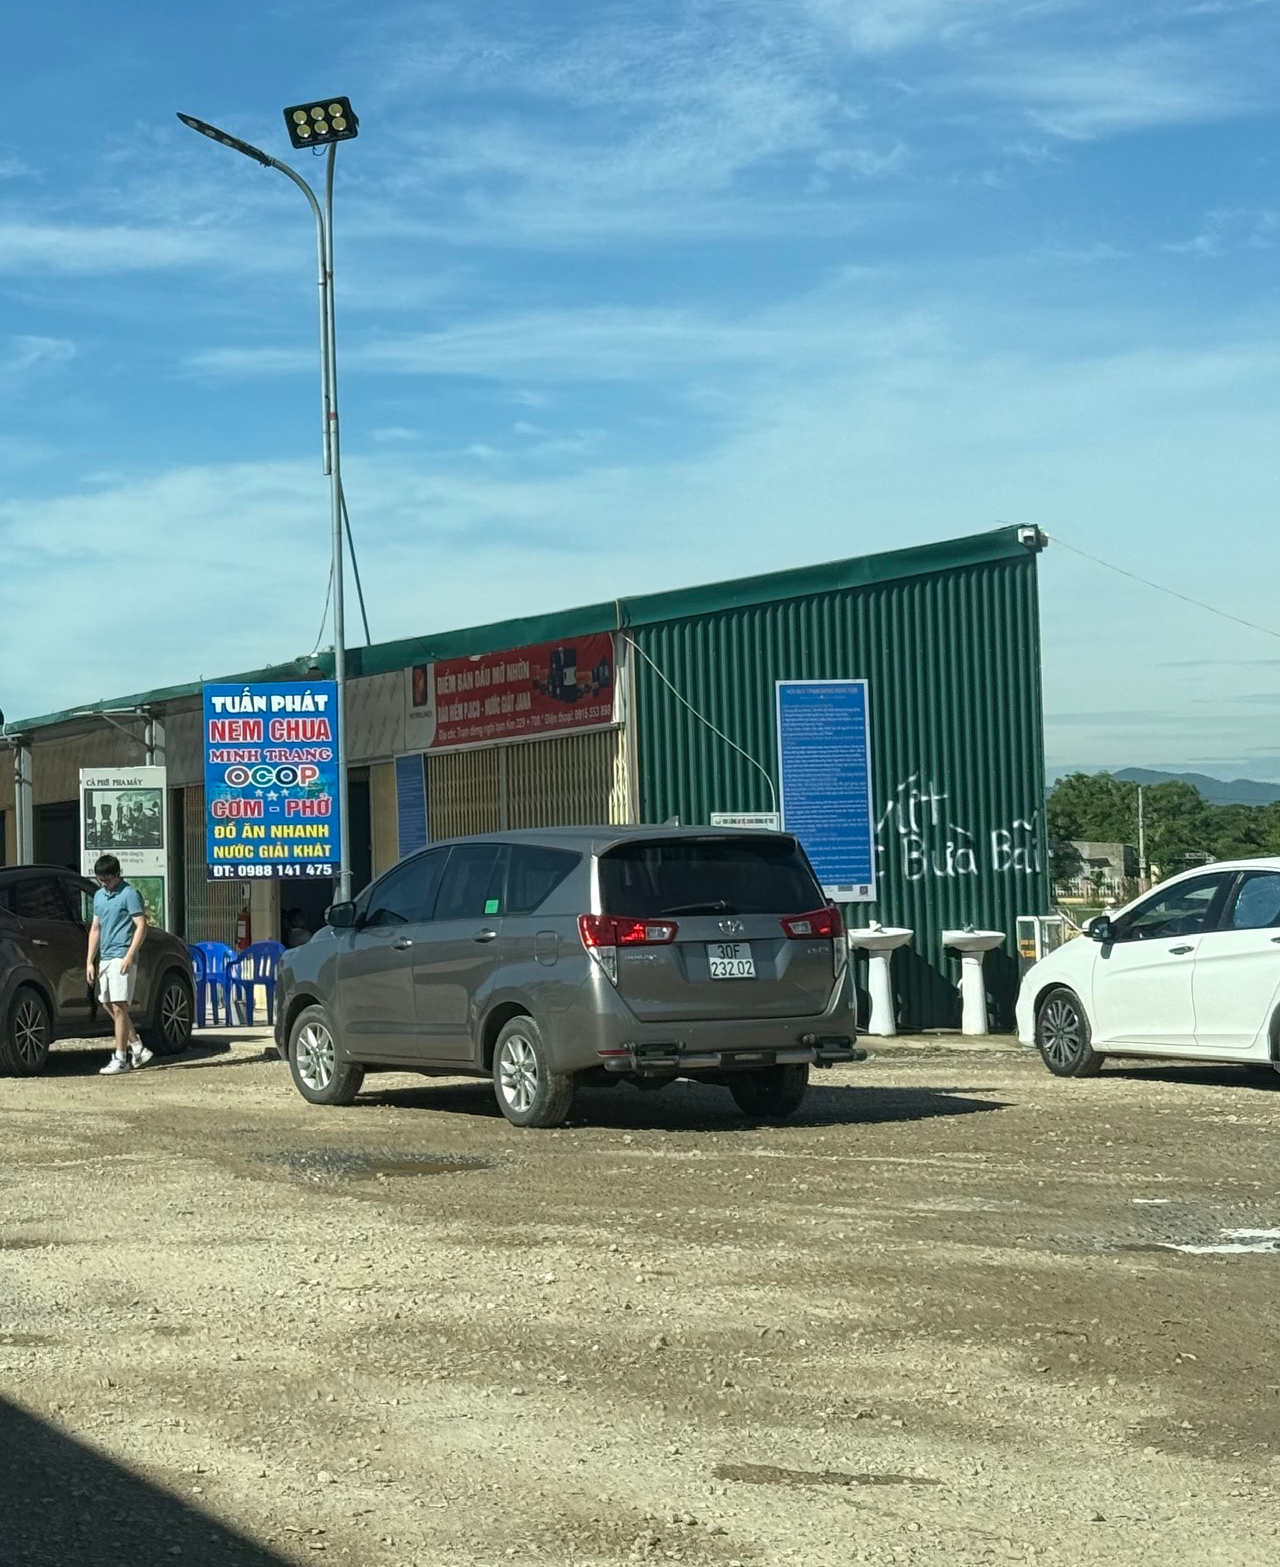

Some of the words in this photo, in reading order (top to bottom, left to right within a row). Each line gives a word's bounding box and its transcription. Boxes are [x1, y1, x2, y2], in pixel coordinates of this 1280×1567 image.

[211, 686, 267, 713] TUẤN
[271, 690, 328, 713] PHÁT
[209, 718, 263, 743] NEM
[269, 716, 332, 742] CHUA
[209, 748, 261, 763] MINH
[263, 747, 332, 763] TRANG
[225, 765, 320, 787] OCOP
[212, 799, 263, 819] CƠM
[285, 793, 332, 817] PHỞ
[214, 821, 237, 839] ĐỒ
[242, 822, 265, 839] ĂN
[270, 824, 329, 839] NHANH
[213, 843, 254, 858] NƯỚC
[258, 842, 289, 858] GIẢI
[293, 843, 332, 858] KHÁT
[213, 864, 234, 877] ĐT:
[238, 864, 273, 876] 0988
[277, 864, 301, 876] 141
[305, 863, 332, 876] 475
[717, 945, 740, 960] 30F
[711, 960, 754, 977] 232.02
